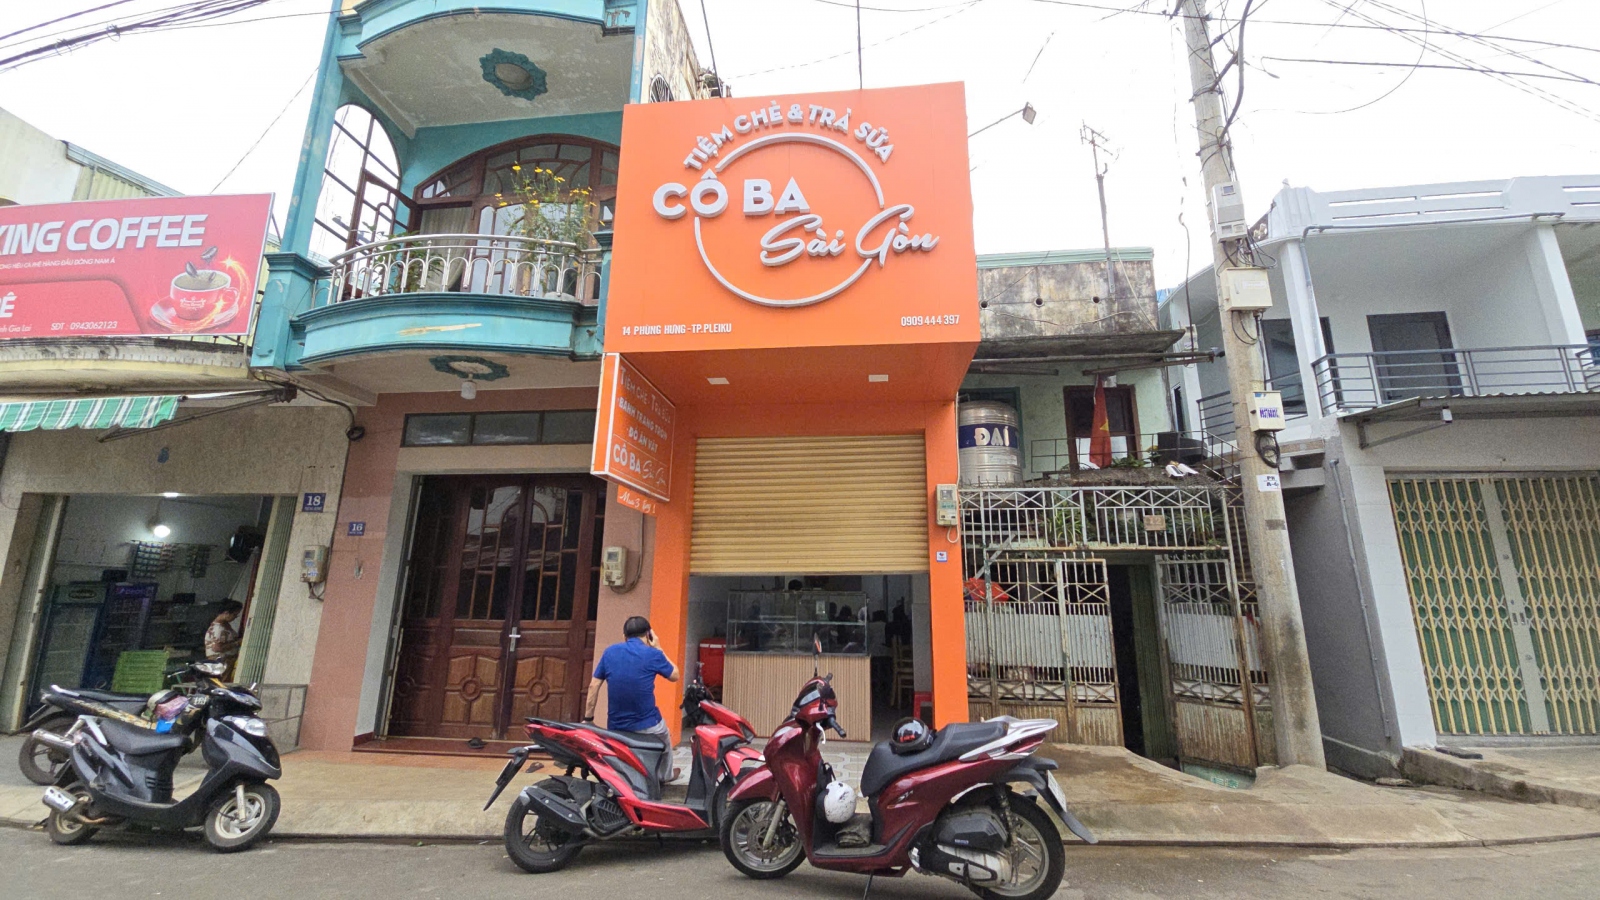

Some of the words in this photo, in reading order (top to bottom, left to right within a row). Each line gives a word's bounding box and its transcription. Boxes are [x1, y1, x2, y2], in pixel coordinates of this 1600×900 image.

[683, 124, 734, 170] TIỆM
[734, 100, 784, 134] CHÈ
[787, 103, 804, 123] &
[854, 122, 894, 164] SỮA
[652, 168, 728, 220] CÔ
[743, 176, 811, 216] BA
[66, 214, 209, 251] COFFEE
[760, 214, 846, 266] Sài
[855, 204, 939, 268] Gòn
[622, 326, 631, 335] 14
[900, 315, 923, 327] 0909
[924, 315, 942, 326] 444
[943, 314, 960, 325] 397
[613, 443, 628, 466] CÔ
[629, 452, 641, 473] BA
[307, 495, 321, 506] 18
[352, 523, 363, 531] 16
